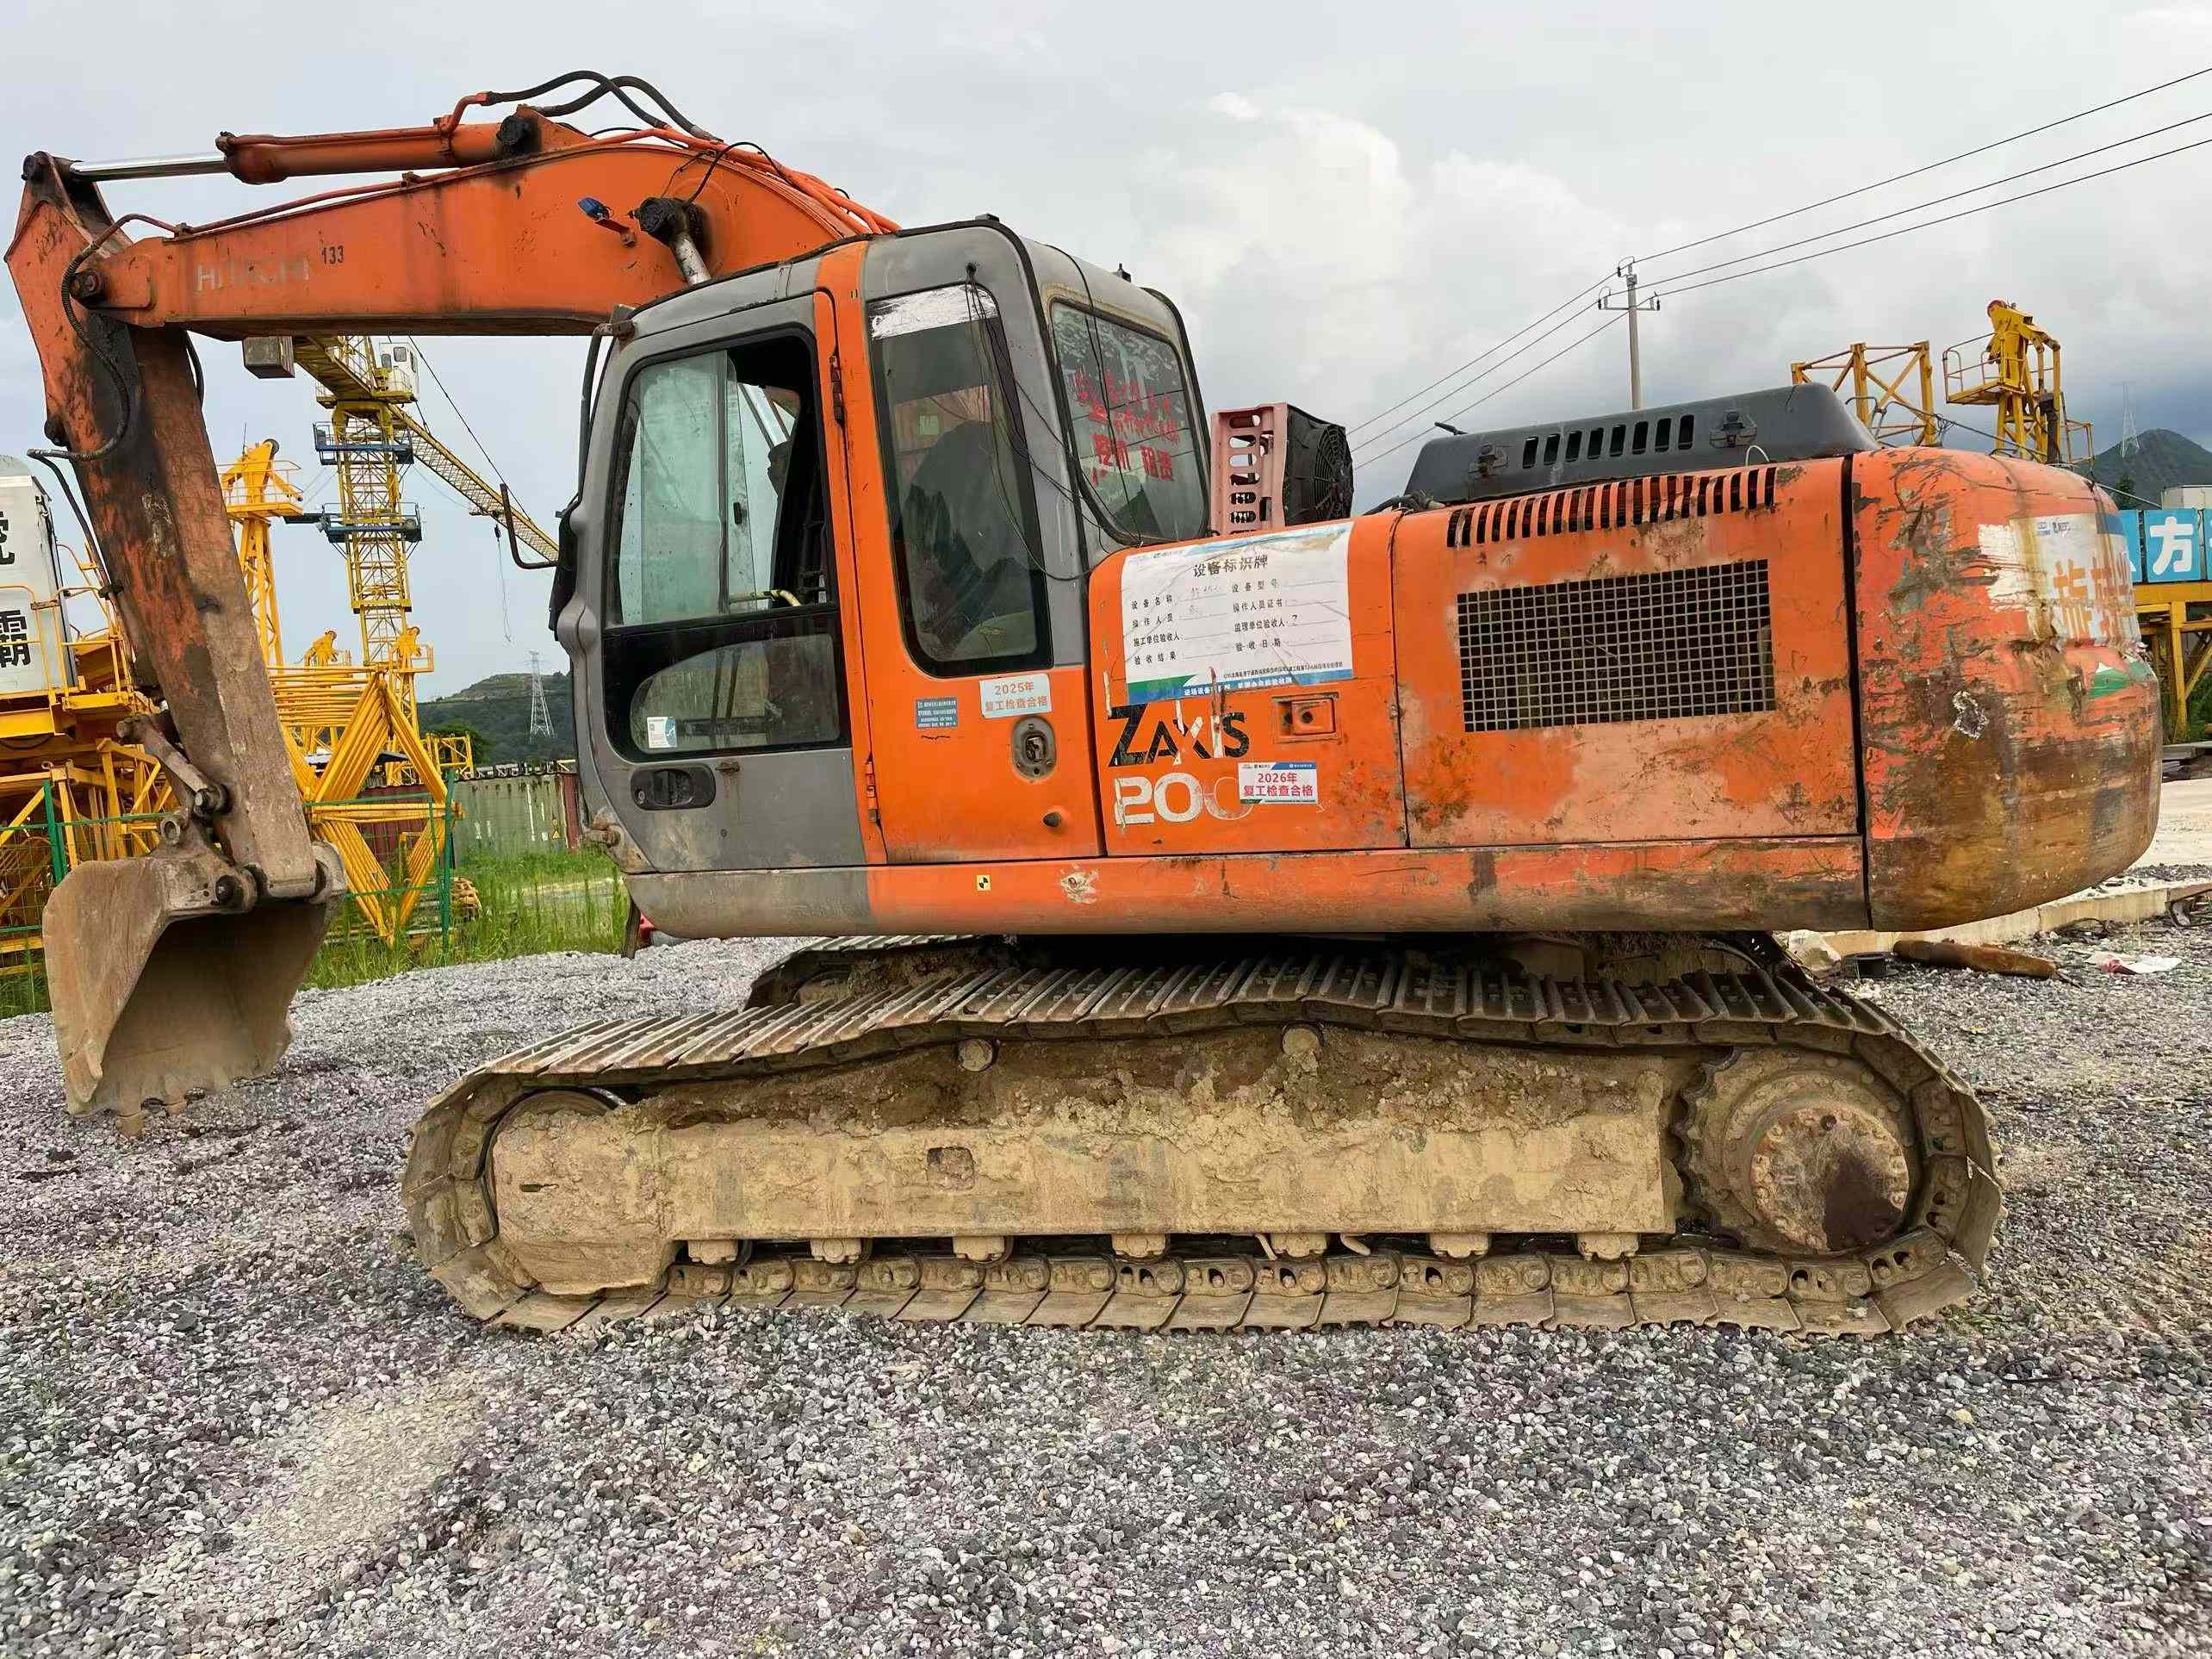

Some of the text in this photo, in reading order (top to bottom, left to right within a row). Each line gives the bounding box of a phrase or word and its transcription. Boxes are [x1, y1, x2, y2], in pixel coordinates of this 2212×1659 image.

[321, 245, 345, 264] 133
[1193, 555, 1269, 577] 设备标识牌
[994, 681, 1035, 696] 2025年
[1108, 703, 1250, 767] ZAXIS
[1258, 772, 1298, 784] 2026年
[1243, 785, 1314, 797] 复工检查合格
